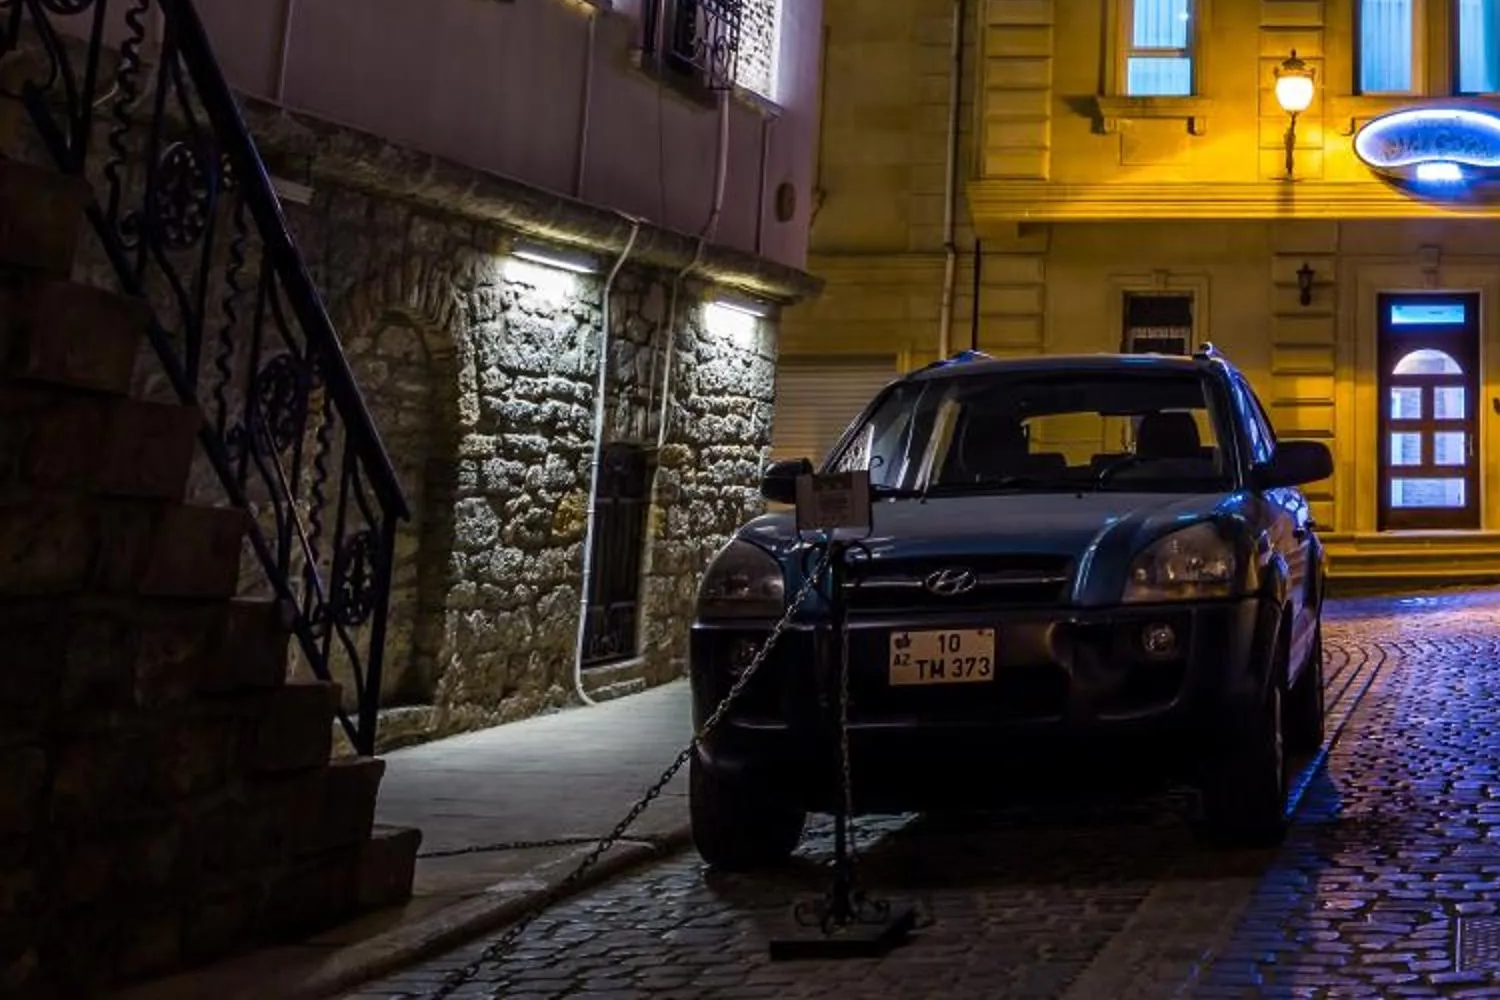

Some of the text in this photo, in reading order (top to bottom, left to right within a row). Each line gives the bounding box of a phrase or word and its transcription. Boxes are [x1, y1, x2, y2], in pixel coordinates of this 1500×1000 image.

[938, 634, 961, 653] 10
[894, 653, 911, 666] AZ
[916, 657, 990, 680] TM 373
